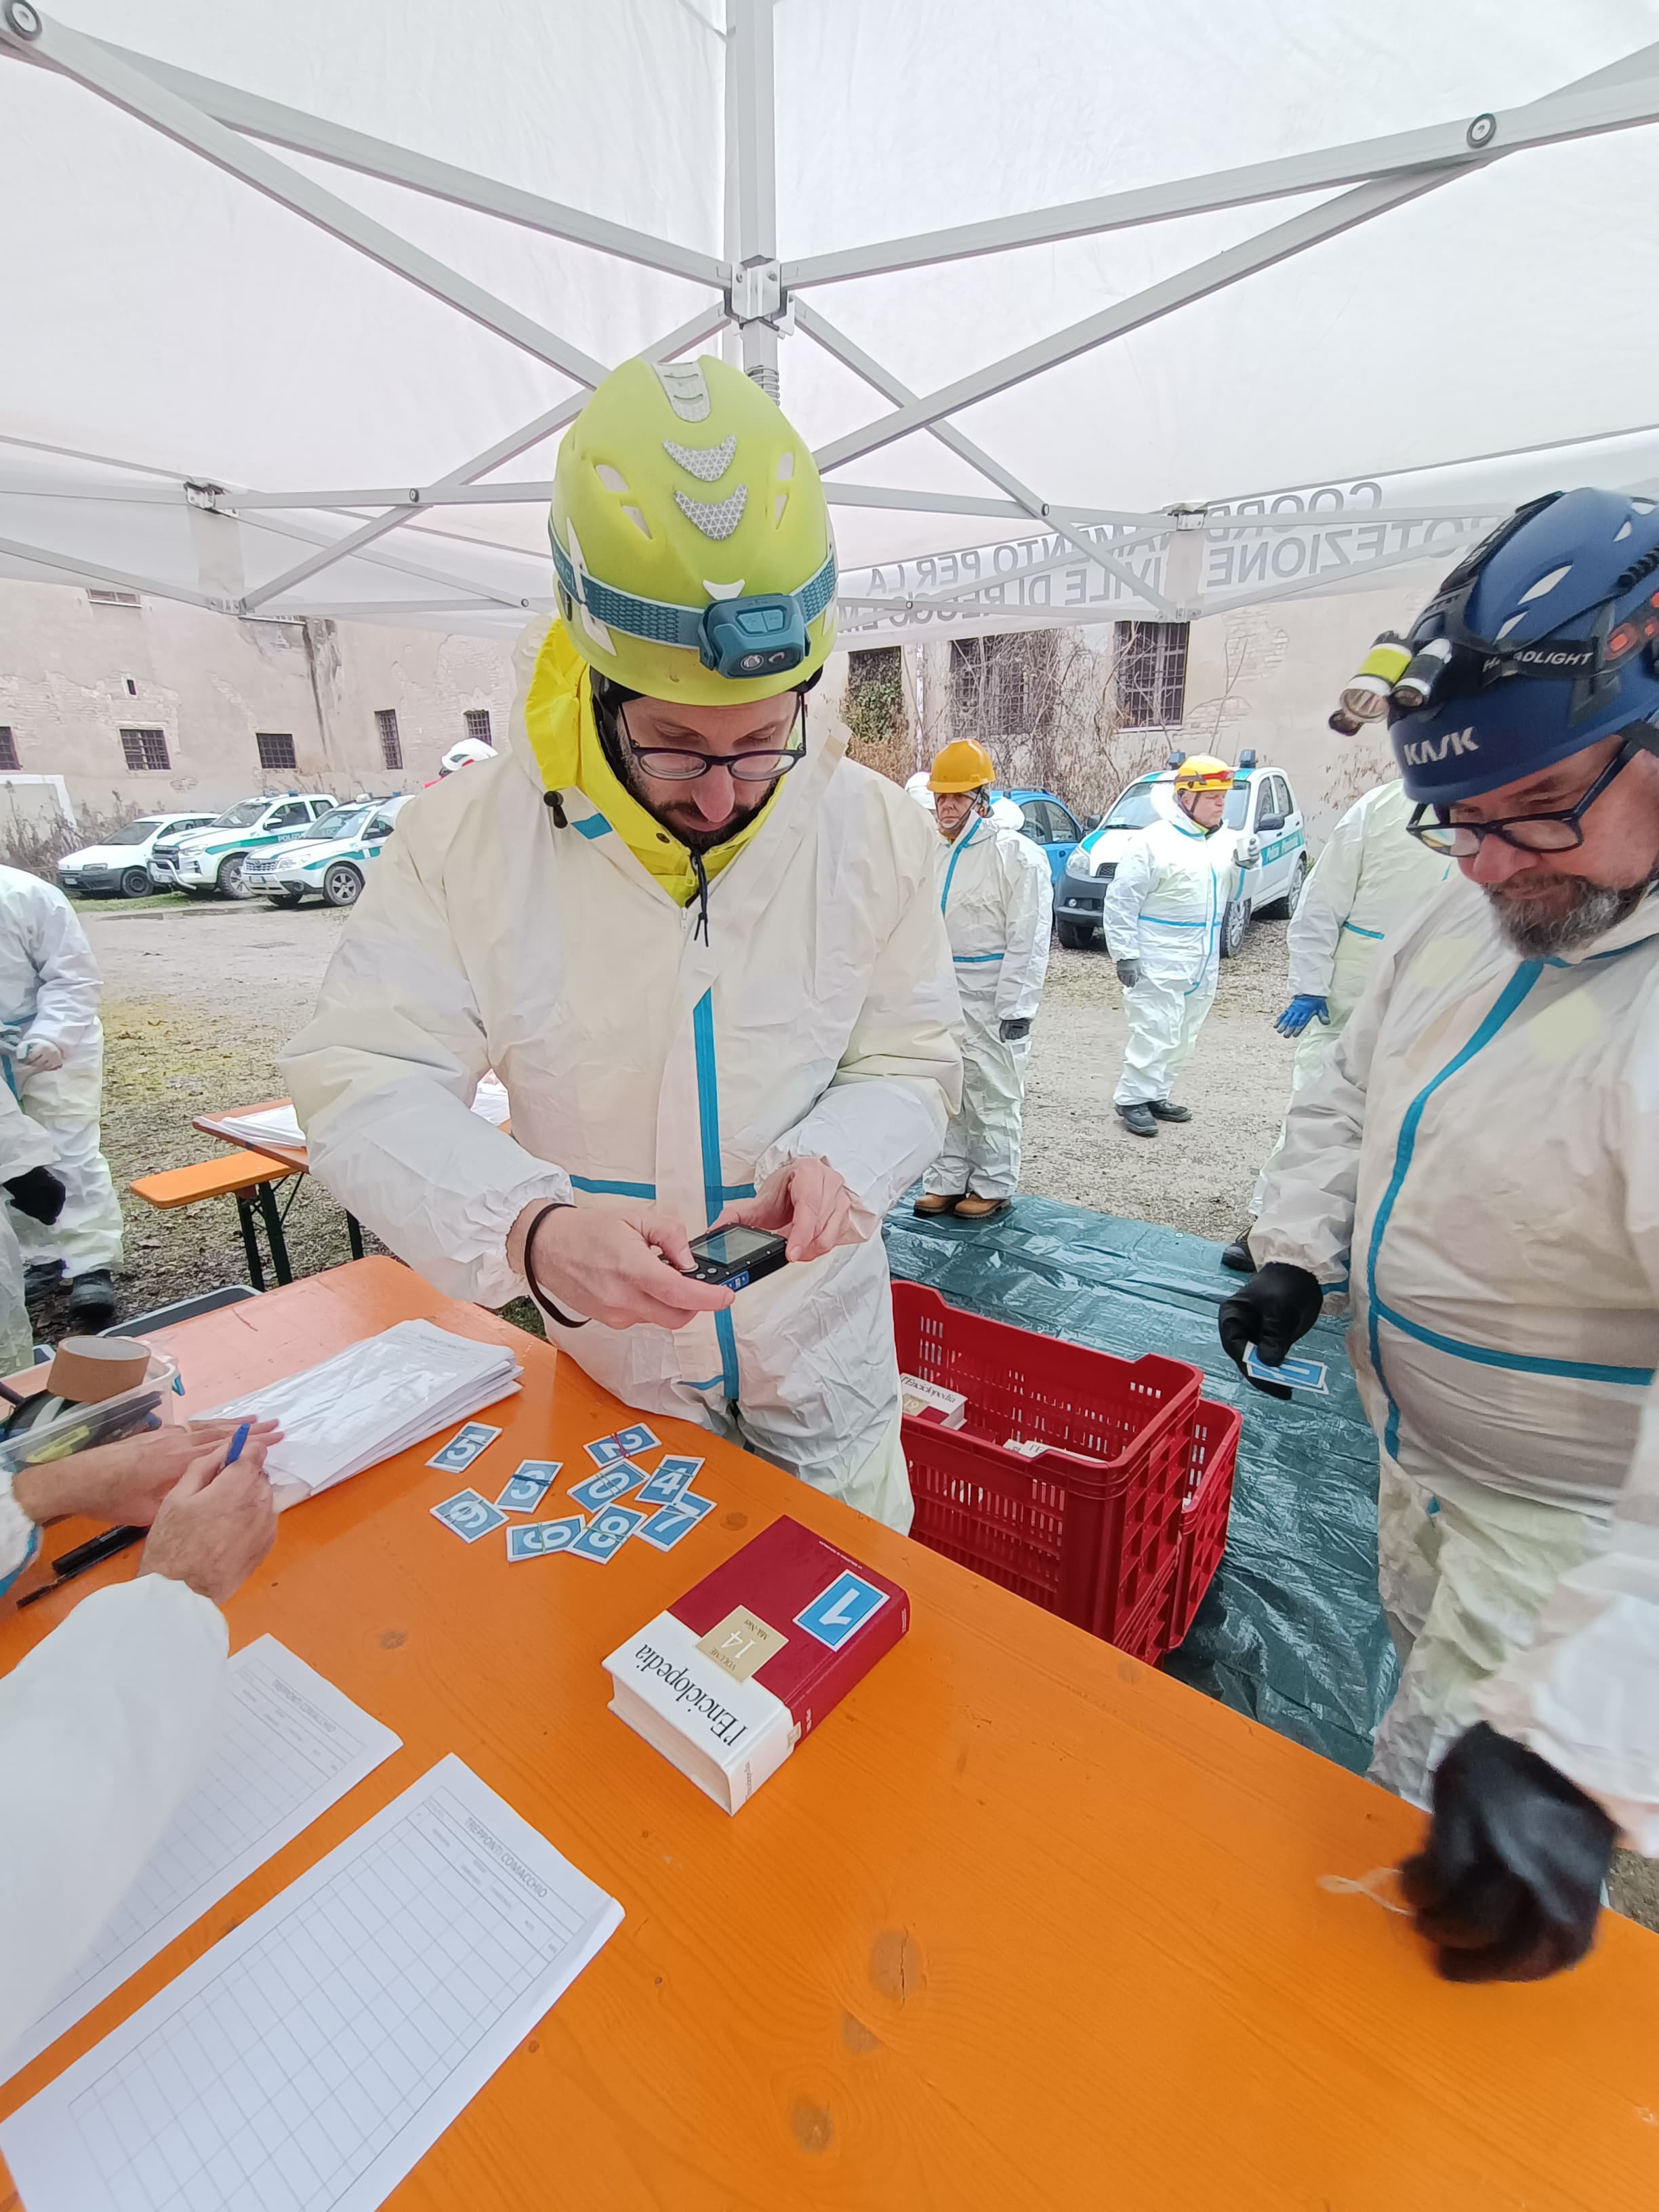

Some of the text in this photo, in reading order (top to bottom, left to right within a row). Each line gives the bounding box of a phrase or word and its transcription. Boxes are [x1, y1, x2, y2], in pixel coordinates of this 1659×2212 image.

[1404, 726, 1479, 766] KASK
[447, 1433, 487, 1460] 5
[607, 1433, 642, 1458] 2
[510, 1469, 546, 1500] 3
[652, 1467, 683, 1495] 4
[589, 1515, 630, 1549] 8
[654, 1500, 701, 1533] 7
[818, 1587, 861, 1625] 1
[709, 1647, 737, 1672] VOLUME
[720, 1630, 757, 1659] 14
[635, 1643, 749, 1746] l'Enciclopedia
[464, 1816, 504, 1857] TREPPONTI
[500, 1851, 548, 1898] COMACCHIO
